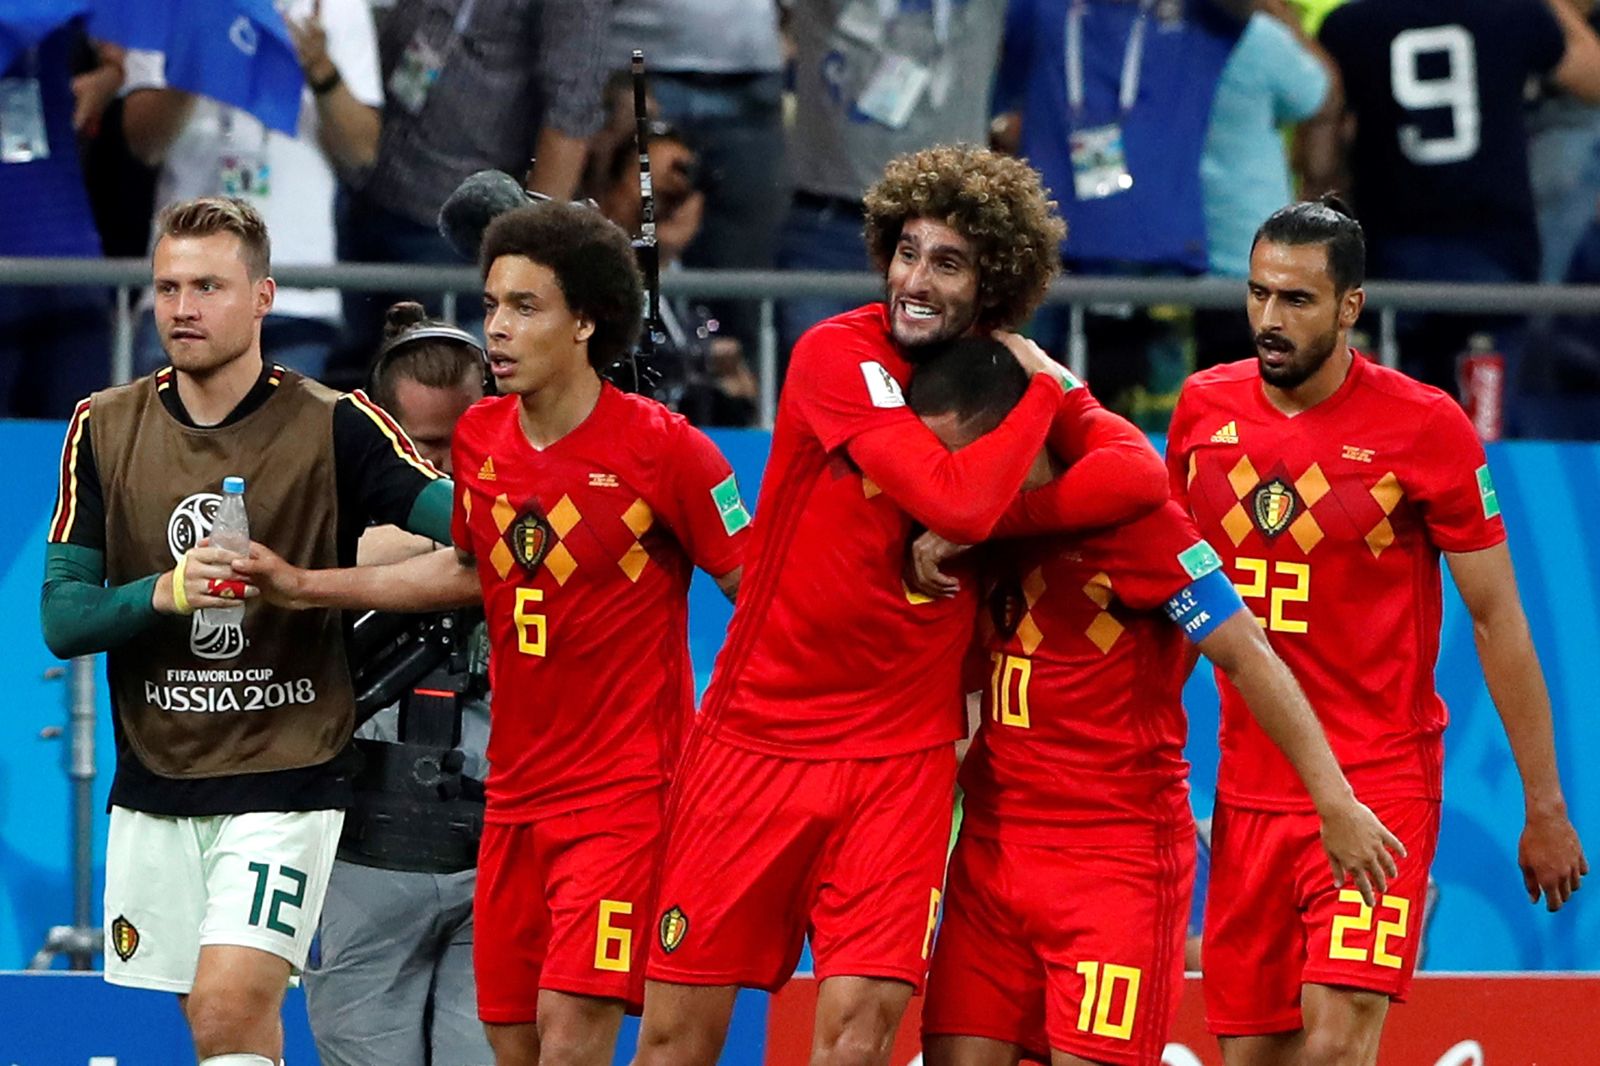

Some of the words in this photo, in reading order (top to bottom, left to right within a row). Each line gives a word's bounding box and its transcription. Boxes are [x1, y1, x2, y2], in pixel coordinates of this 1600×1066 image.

[1390, 24, 1481, 165] 9
[514, 587, 547, 657] 6
[1185, 610, 1211, 633] FIFA
[1233, 557, 1310, 633] 22
[145, 680, 241, 712] RUSSIA
[243, 678, 316, 711] 2018
[167, 669, 196, 682] FIFA
[197, 670, 243, 682] WORLD
[245, 669, 273, 681] CUP
[990, 652, 1031, 728] 10
[247, 861, 307, 938] 12
[594, 900, 633, 972] 6
[1328, 889, 1410, 969] 22
[1076, 961, 1141, 1040] 10
